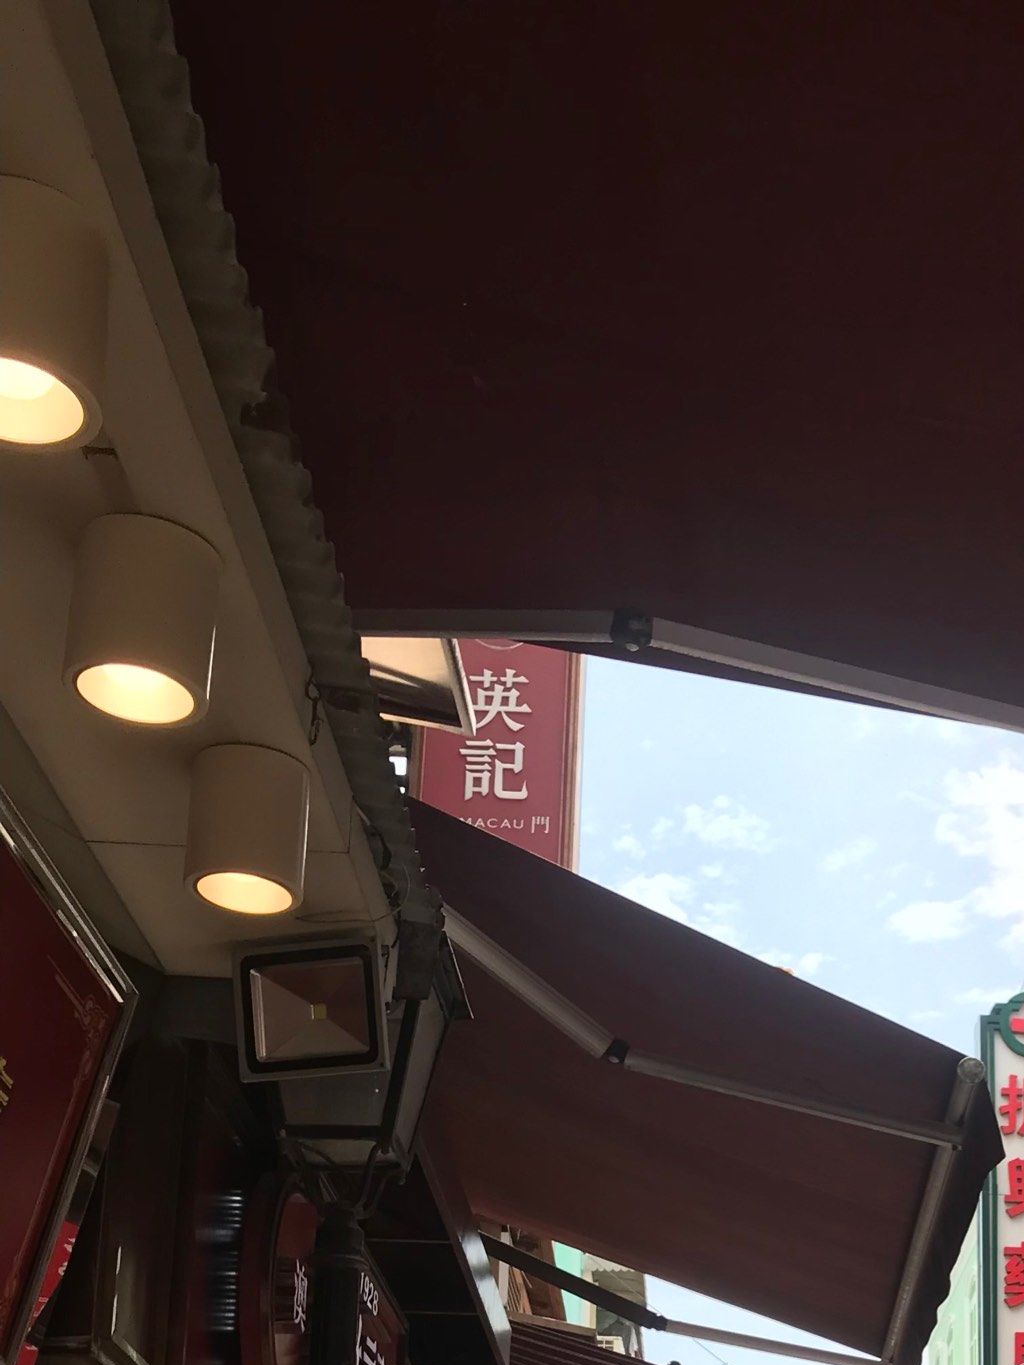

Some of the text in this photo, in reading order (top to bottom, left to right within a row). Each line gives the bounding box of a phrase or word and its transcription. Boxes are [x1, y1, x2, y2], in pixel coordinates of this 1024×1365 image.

[458, 667, 533, 801] 英記
[530, 815, 550, 834] 門
[359, 1270, 380, 1317] 1928
